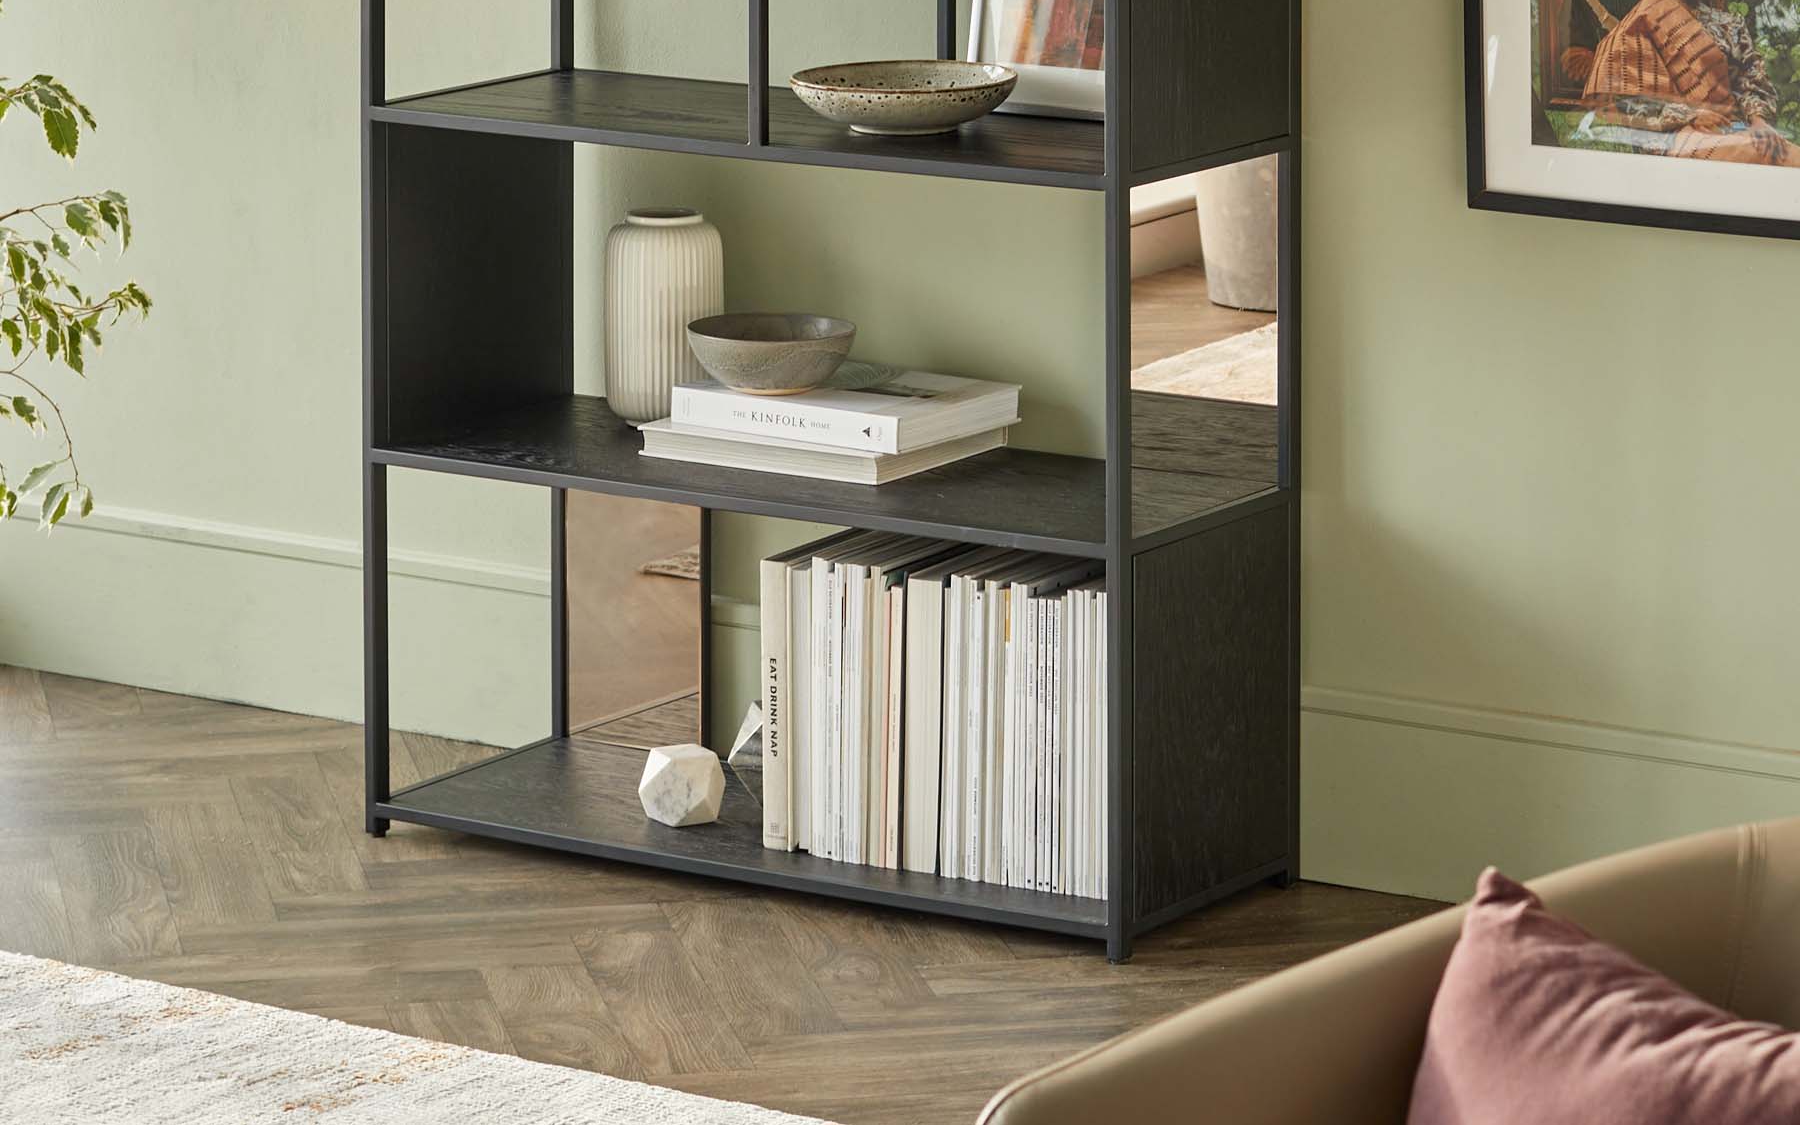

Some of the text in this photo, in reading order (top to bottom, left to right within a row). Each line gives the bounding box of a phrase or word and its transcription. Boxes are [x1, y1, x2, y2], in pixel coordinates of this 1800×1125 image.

[732, 410, 830, 430] THE KINFOLK HOME
[769, 658, 778, 757] EAT DRINK NAP
